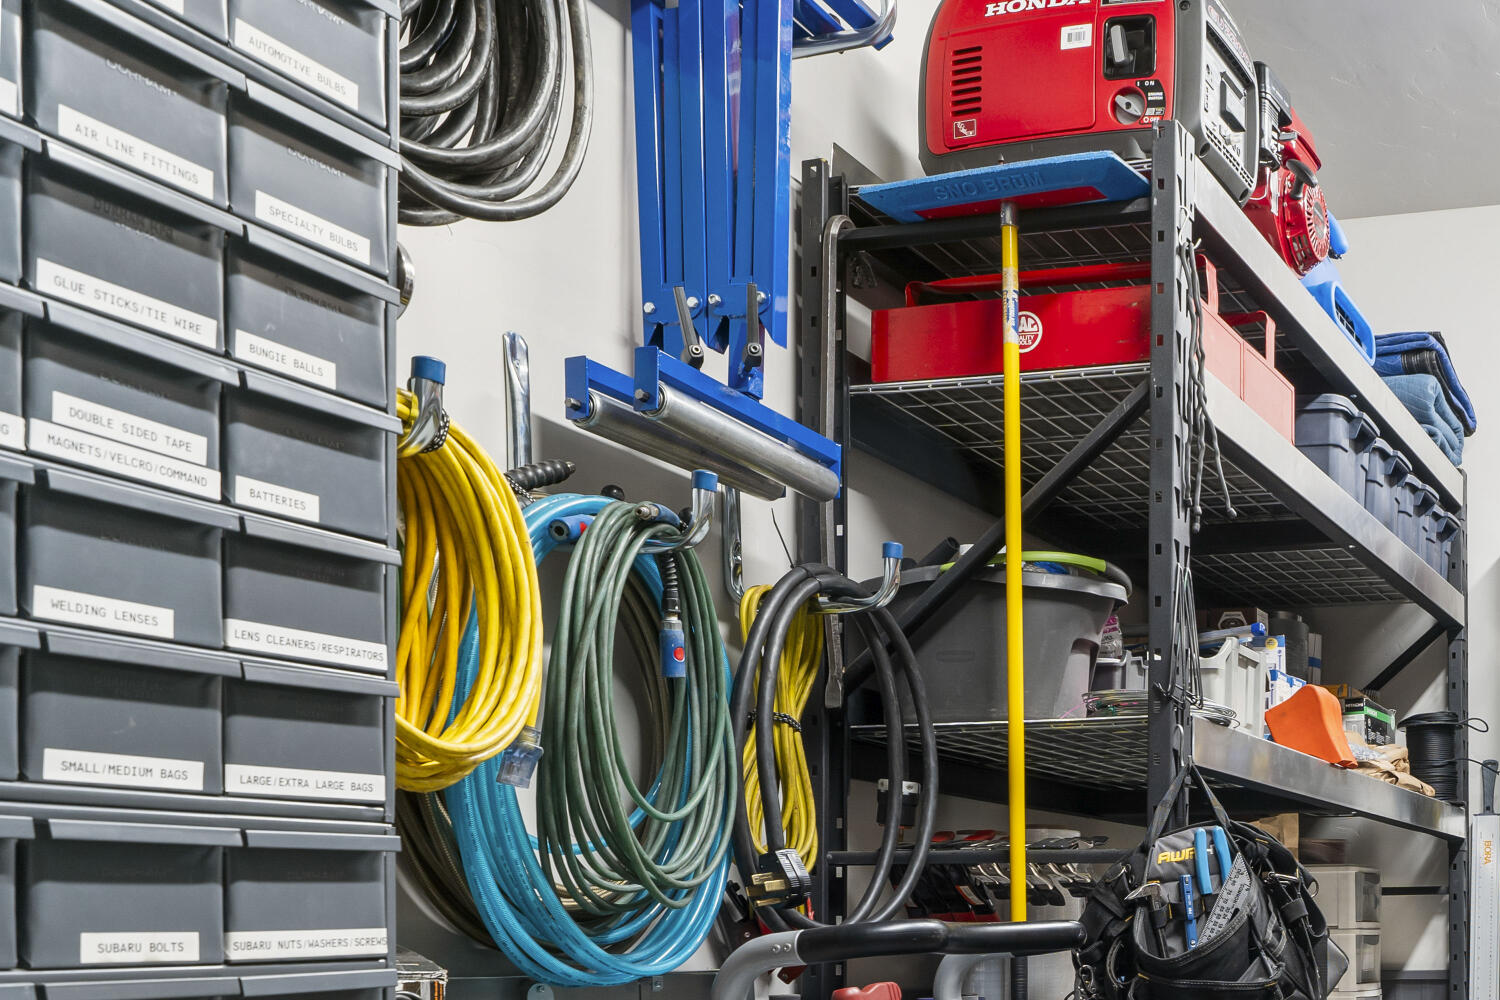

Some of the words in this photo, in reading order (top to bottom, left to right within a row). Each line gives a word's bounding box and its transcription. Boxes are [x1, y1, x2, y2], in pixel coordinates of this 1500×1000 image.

[248, 35, 311, 77] AUTOMOTIVE
[317, 72, 346, 96] BULBS
[75, 123, 99, 142] AIR
[107, 135, 135, 157] LINE
[143, 152, 199, 184] FITTINGS
[269, 205, 323, 237] SPECIALTY
[329, 230, 358, 253] BULBS
[54, 275, 85, 295] GLUE
[94, 288, 167, 325] STICKS/TIE
[175, 314, 201, 335] WIRE
[249, 343, 286, 366] BUNGIE
[293, 356, 323, 377] BALLS
[69, 407, 113, 431] DOUBLE
[122, 423, 157, 443] SIDED
[165, 434, 192, 453] TAPE
[48, 433, 207, 488] MAGNETS/VELCRO/COMMAND
[249, 489, 306, 511] BATTERIES
[51, 599, 106, 619] WELDING
[115, 610, 158, 627] LENSES
[234, 629, 260, 642] LENS
[266, 634, 383, 662] CLEANERS/RESPIRATORS
[61, 761, 153, 778] SMALL/MEDIUM
[160, 767, 188, 780] BAGS
[240, 775, 308, 788] LARGE/EXTRA
[316, 778, 344, 791] LARGE
[351, 780, 373, 793] BAGS
[97, 942, 141, 953] SUBARU
[150, 941, 184, 952] BOLTS
[233, 939, 271, 951] SUBARU
[278, 936, 387, 949] NUTS/WASHERS/SCREWS
